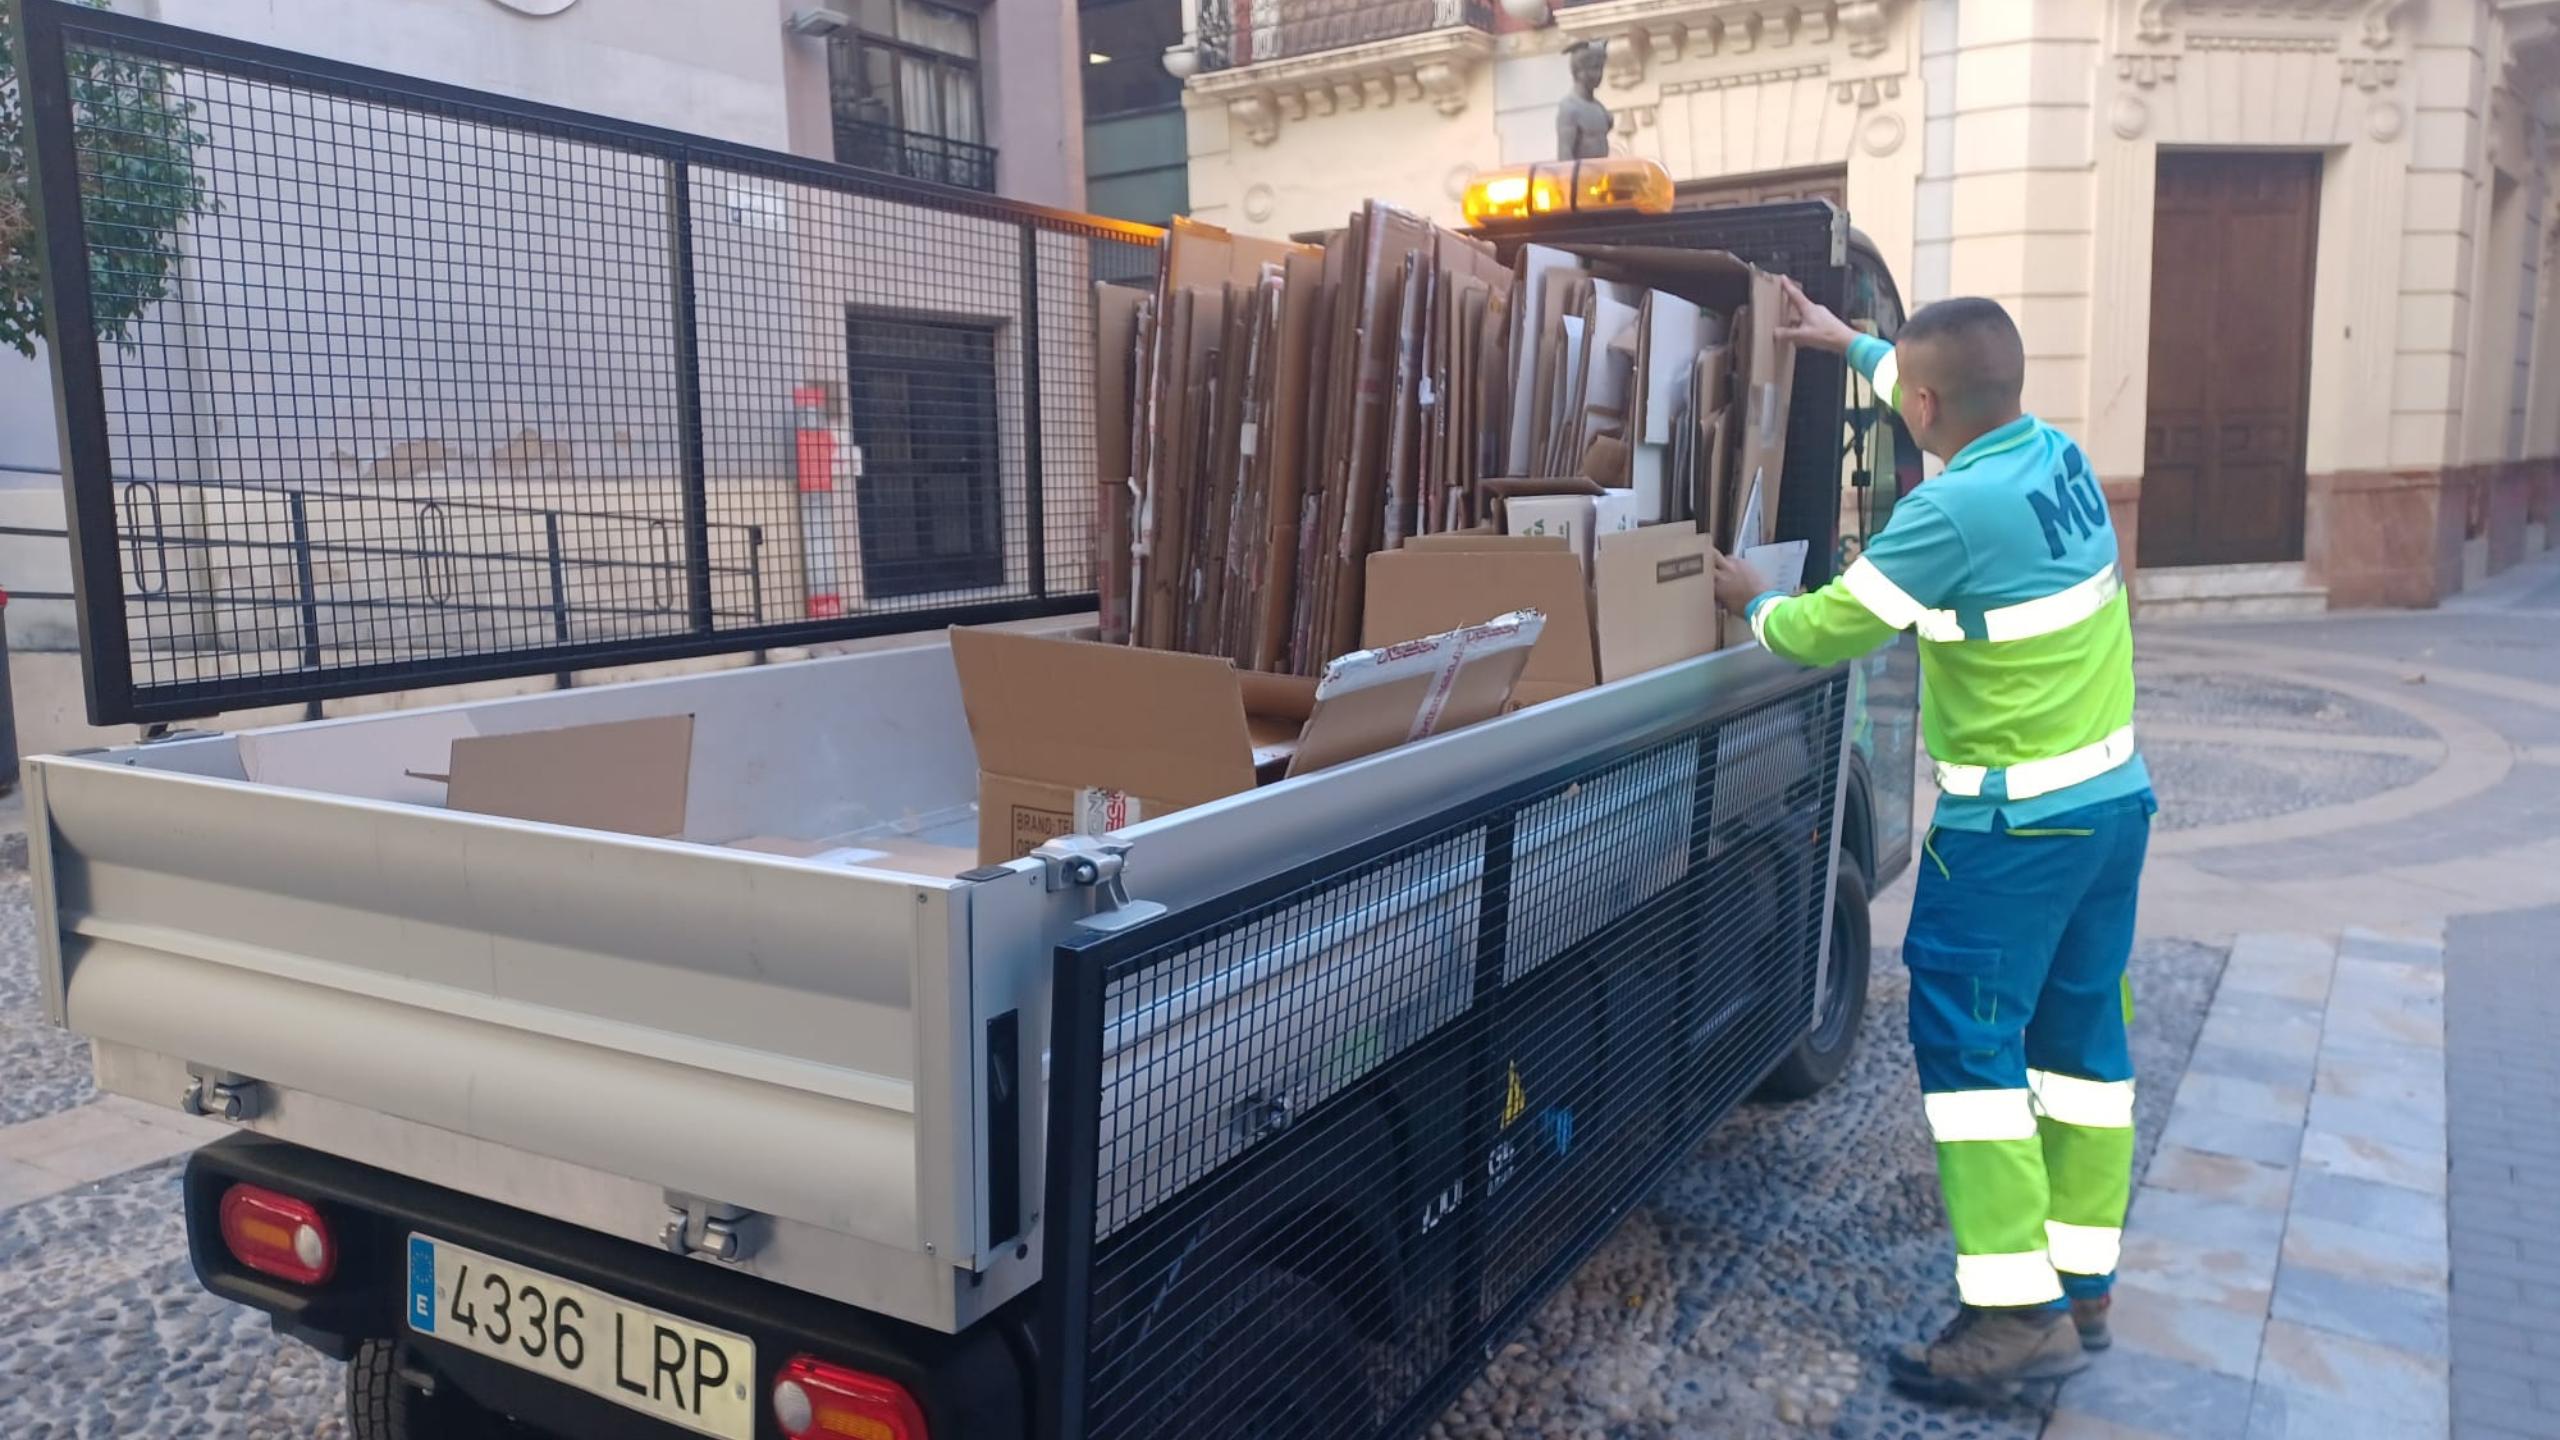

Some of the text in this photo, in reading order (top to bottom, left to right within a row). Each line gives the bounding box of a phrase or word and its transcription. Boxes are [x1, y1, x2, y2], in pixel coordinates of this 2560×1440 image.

[416, 1294, 428, 1316] E
[451, 1265, 729, 1415] 4336 LRP
